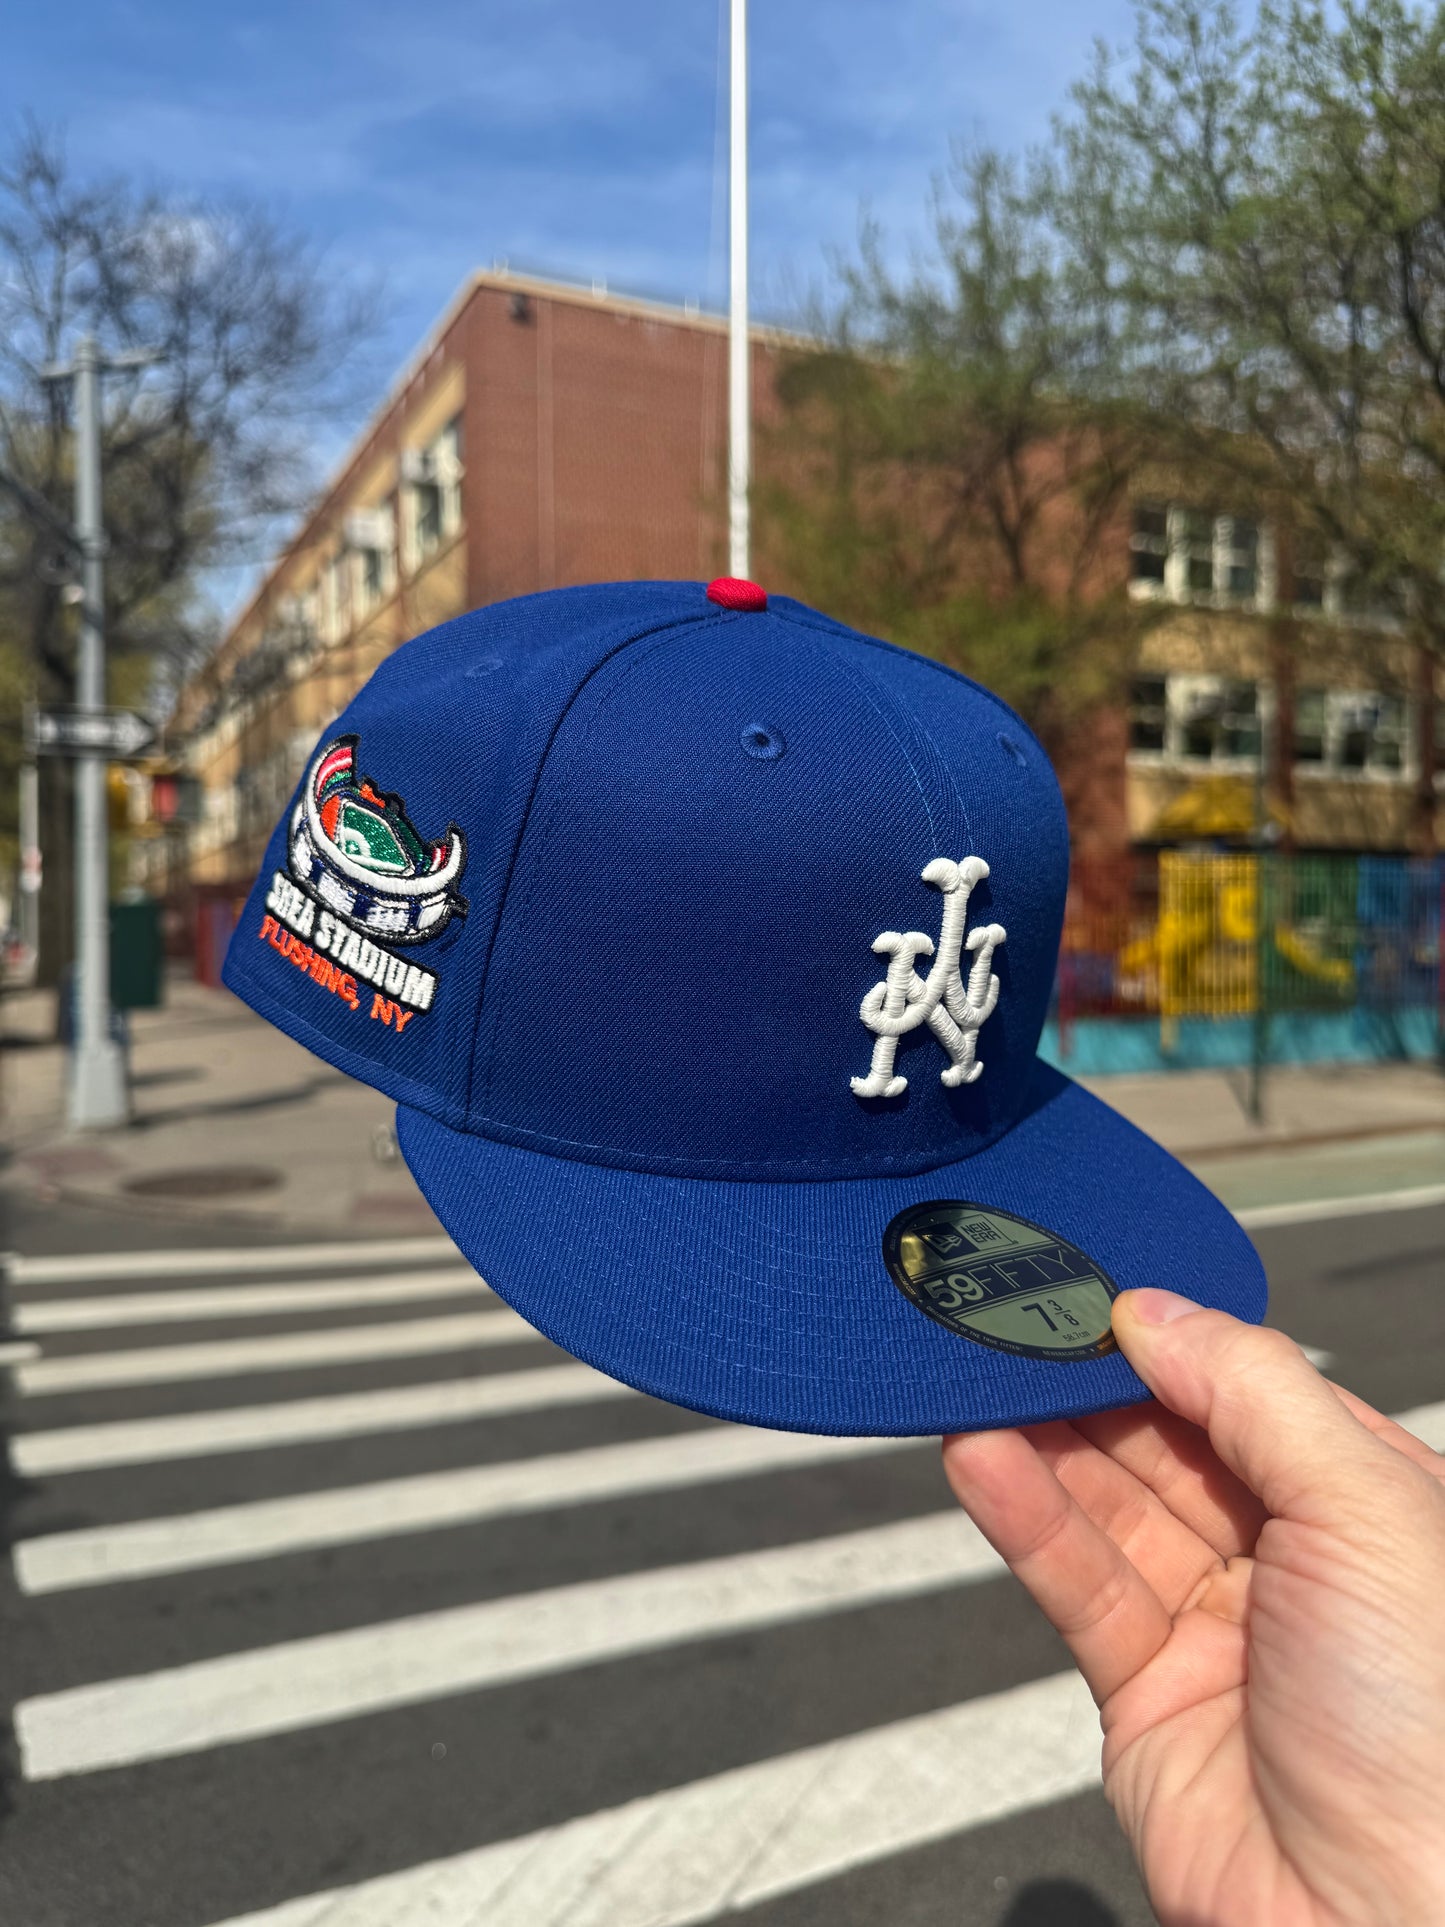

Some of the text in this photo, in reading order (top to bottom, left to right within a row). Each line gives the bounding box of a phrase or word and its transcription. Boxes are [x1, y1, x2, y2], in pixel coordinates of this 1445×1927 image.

[265, 870, 437, 1011] SHEA STADIUM
[370, 993, 414, 1033] NY
[960, 1221, 991, 1236] NEW
[970, 1230, 1002, 1244] ERA
[923, 1249, 1076, 1309] 59FIFTY
